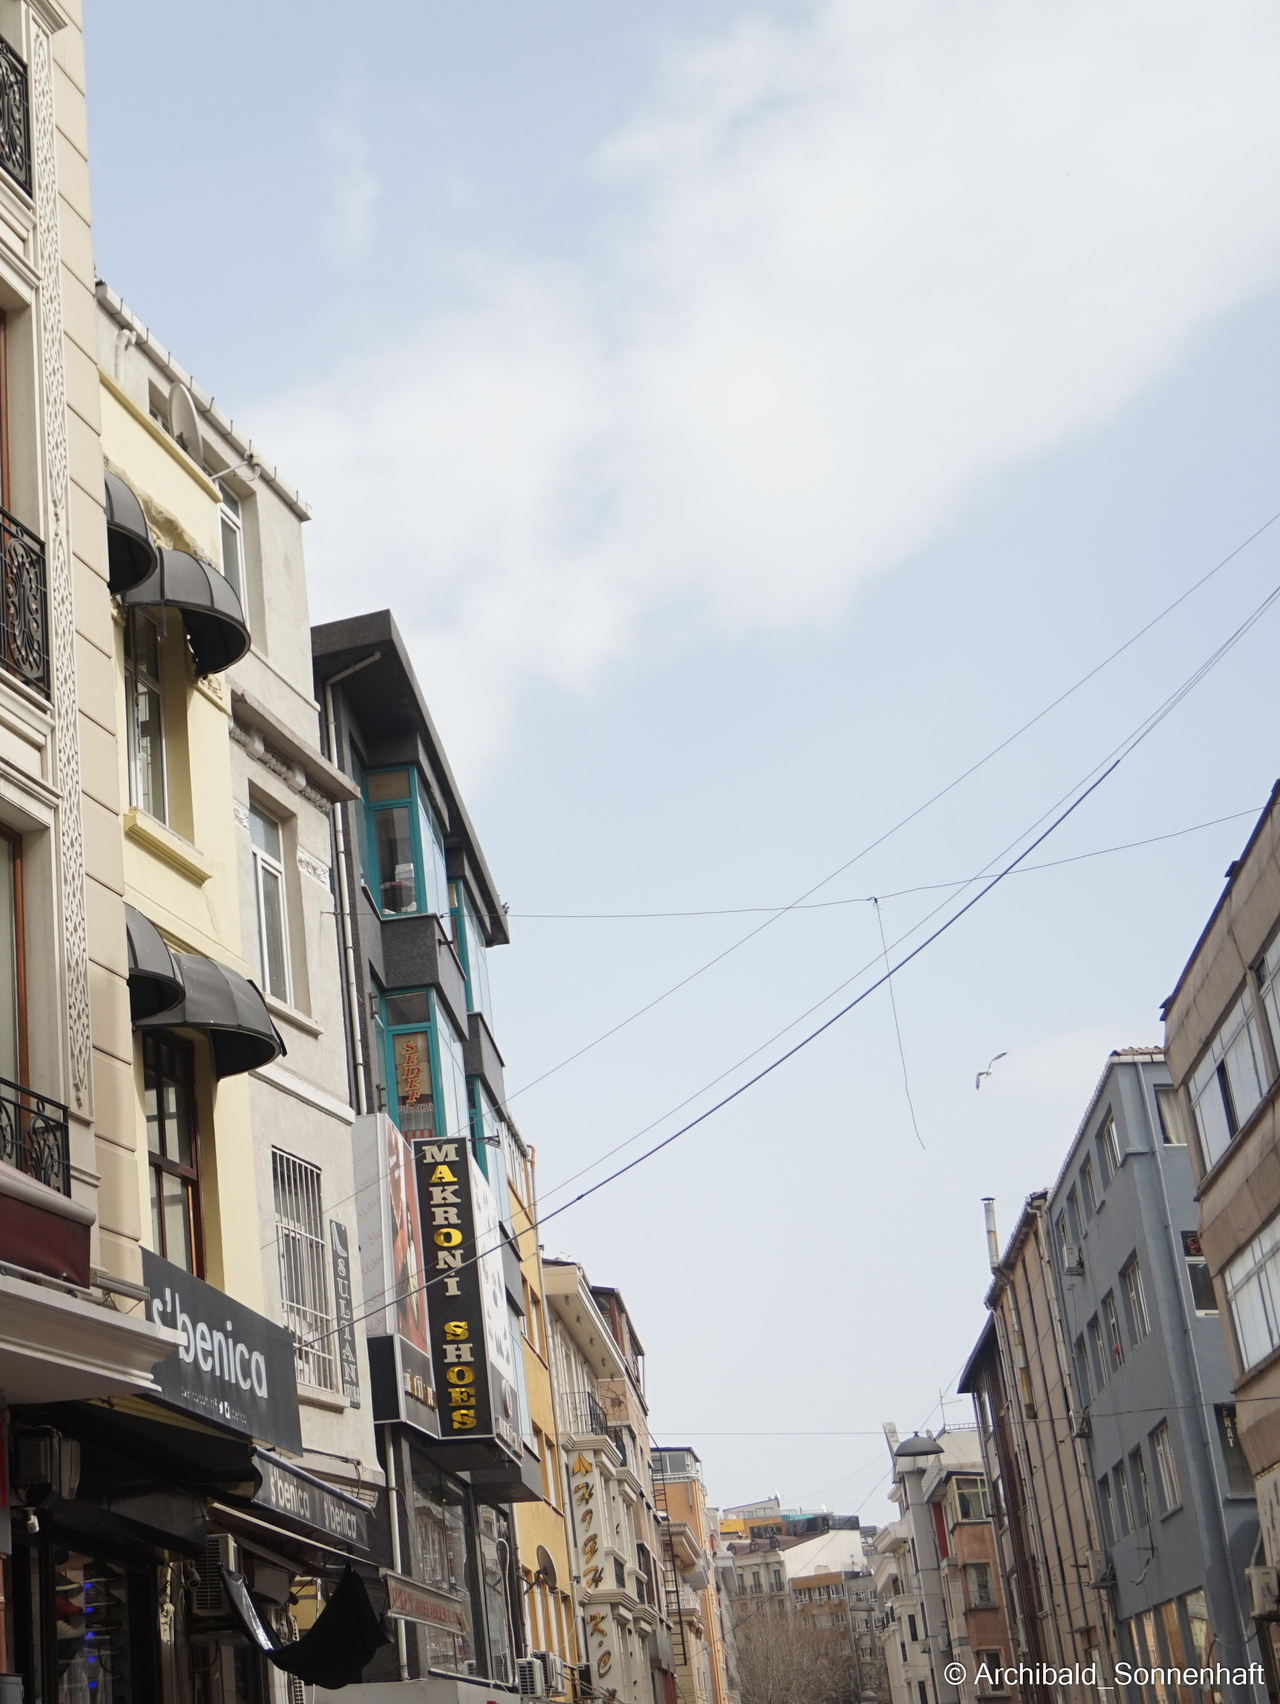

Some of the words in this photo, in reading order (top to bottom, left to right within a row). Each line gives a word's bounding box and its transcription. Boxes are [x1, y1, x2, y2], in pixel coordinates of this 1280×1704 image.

[402, 1040, 422, 1103] SEDEF
[336, 1258, 357, 1383] SULTAN
[444, 1321, 477, 1430] SHOES
